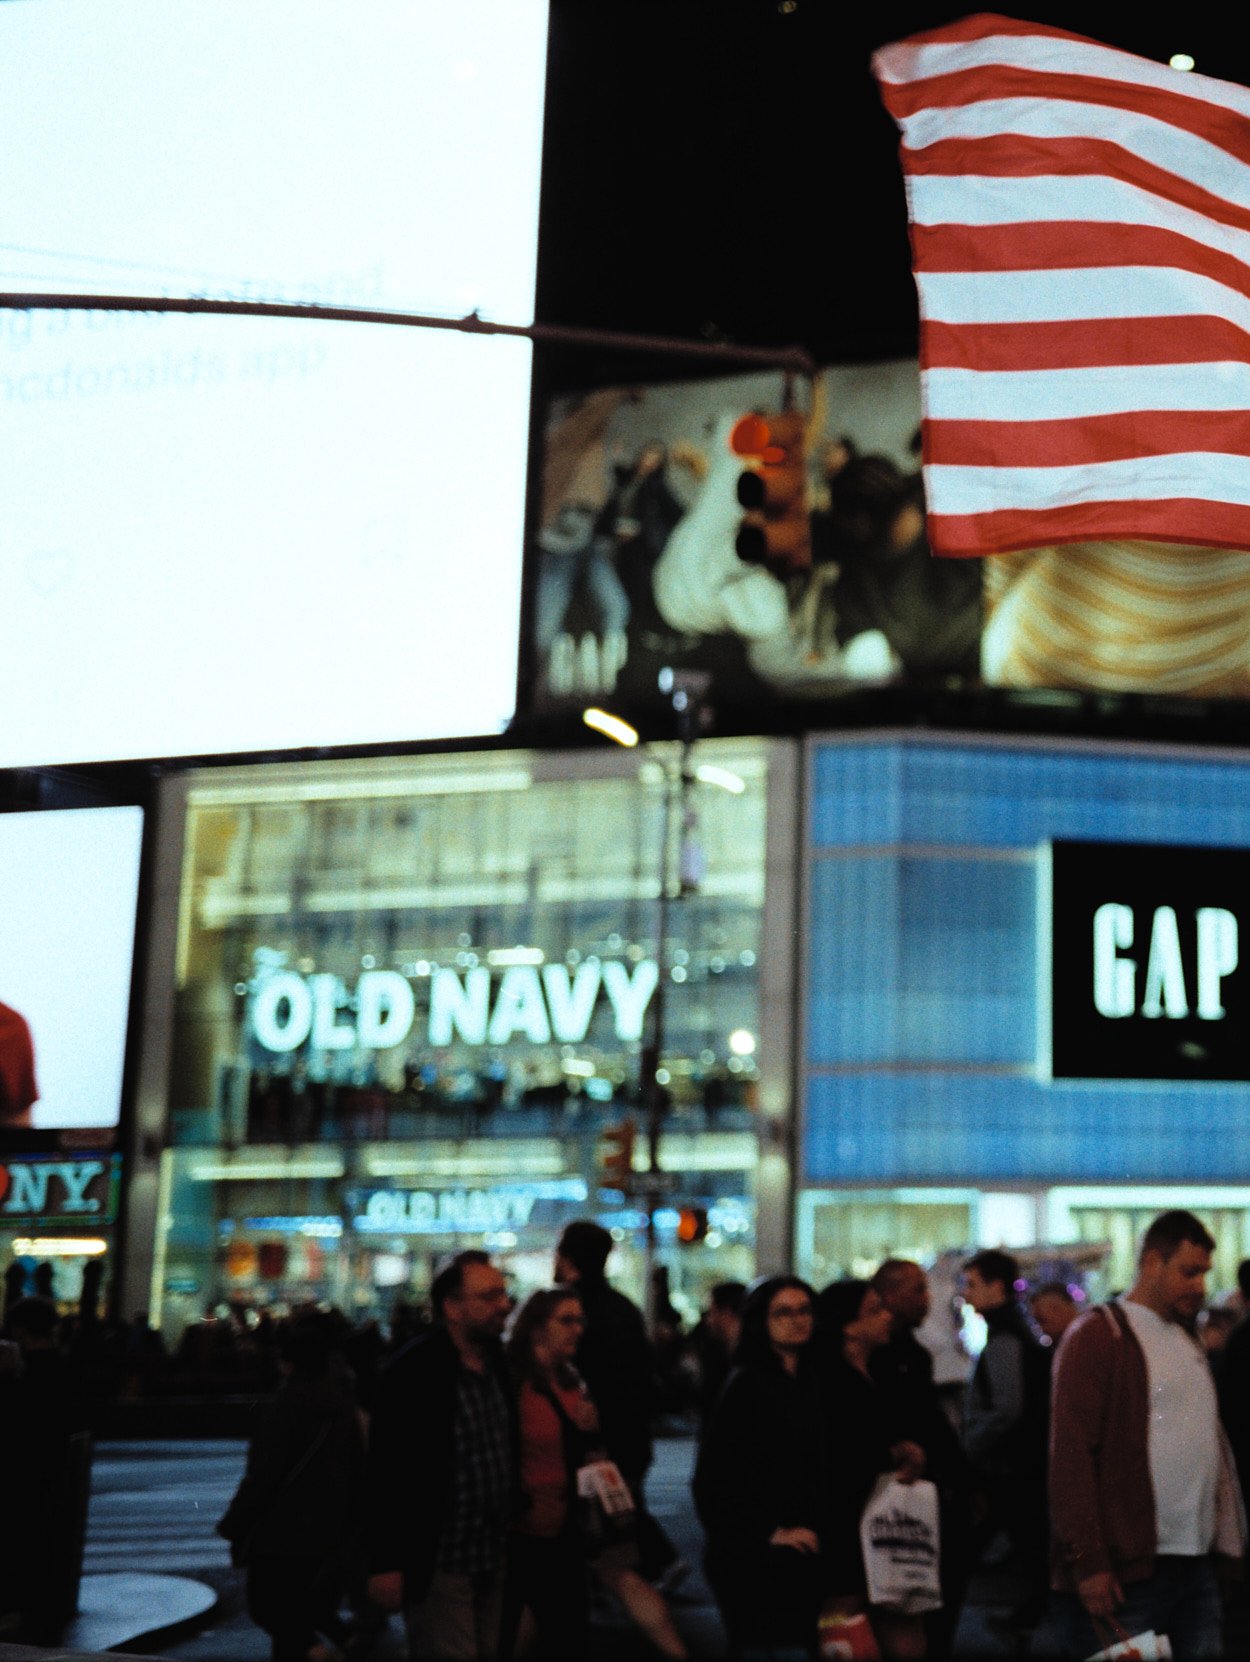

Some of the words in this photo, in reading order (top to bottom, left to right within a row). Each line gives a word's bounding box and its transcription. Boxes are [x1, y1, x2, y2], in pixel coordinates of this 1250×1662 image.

[252, 967, 416, 1053] OLD
[427, 958, 660, 1047] NAVY
[1092, 902, 1240, 1021] GAP
